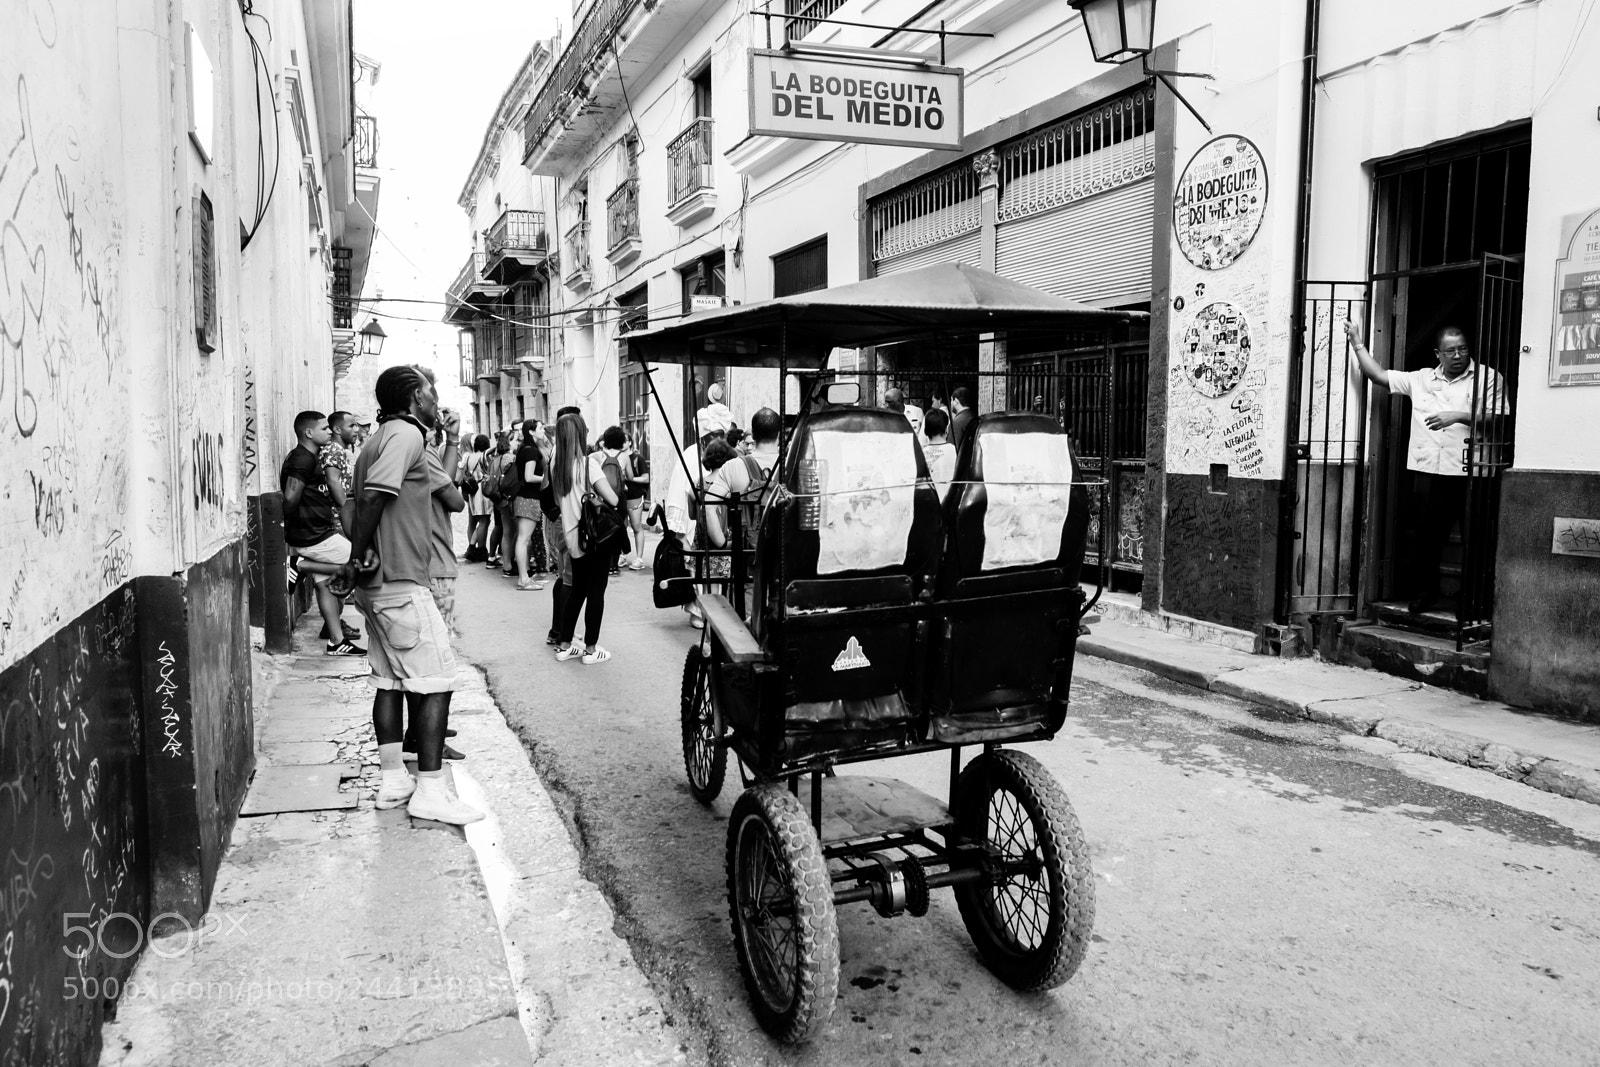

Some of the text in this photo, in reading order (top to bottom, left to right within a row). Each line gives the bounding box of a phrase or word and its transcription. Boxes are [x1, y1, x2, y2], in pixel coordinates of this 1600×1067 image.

[771, 71, 942, 105] LA BODEGUITA
[772, 92, 945, 131] DEL MEDIO
[1182, 167, 1258, 206] LA BODEGUITA
[1223, 414, 1254, 437] LA FLOTA
